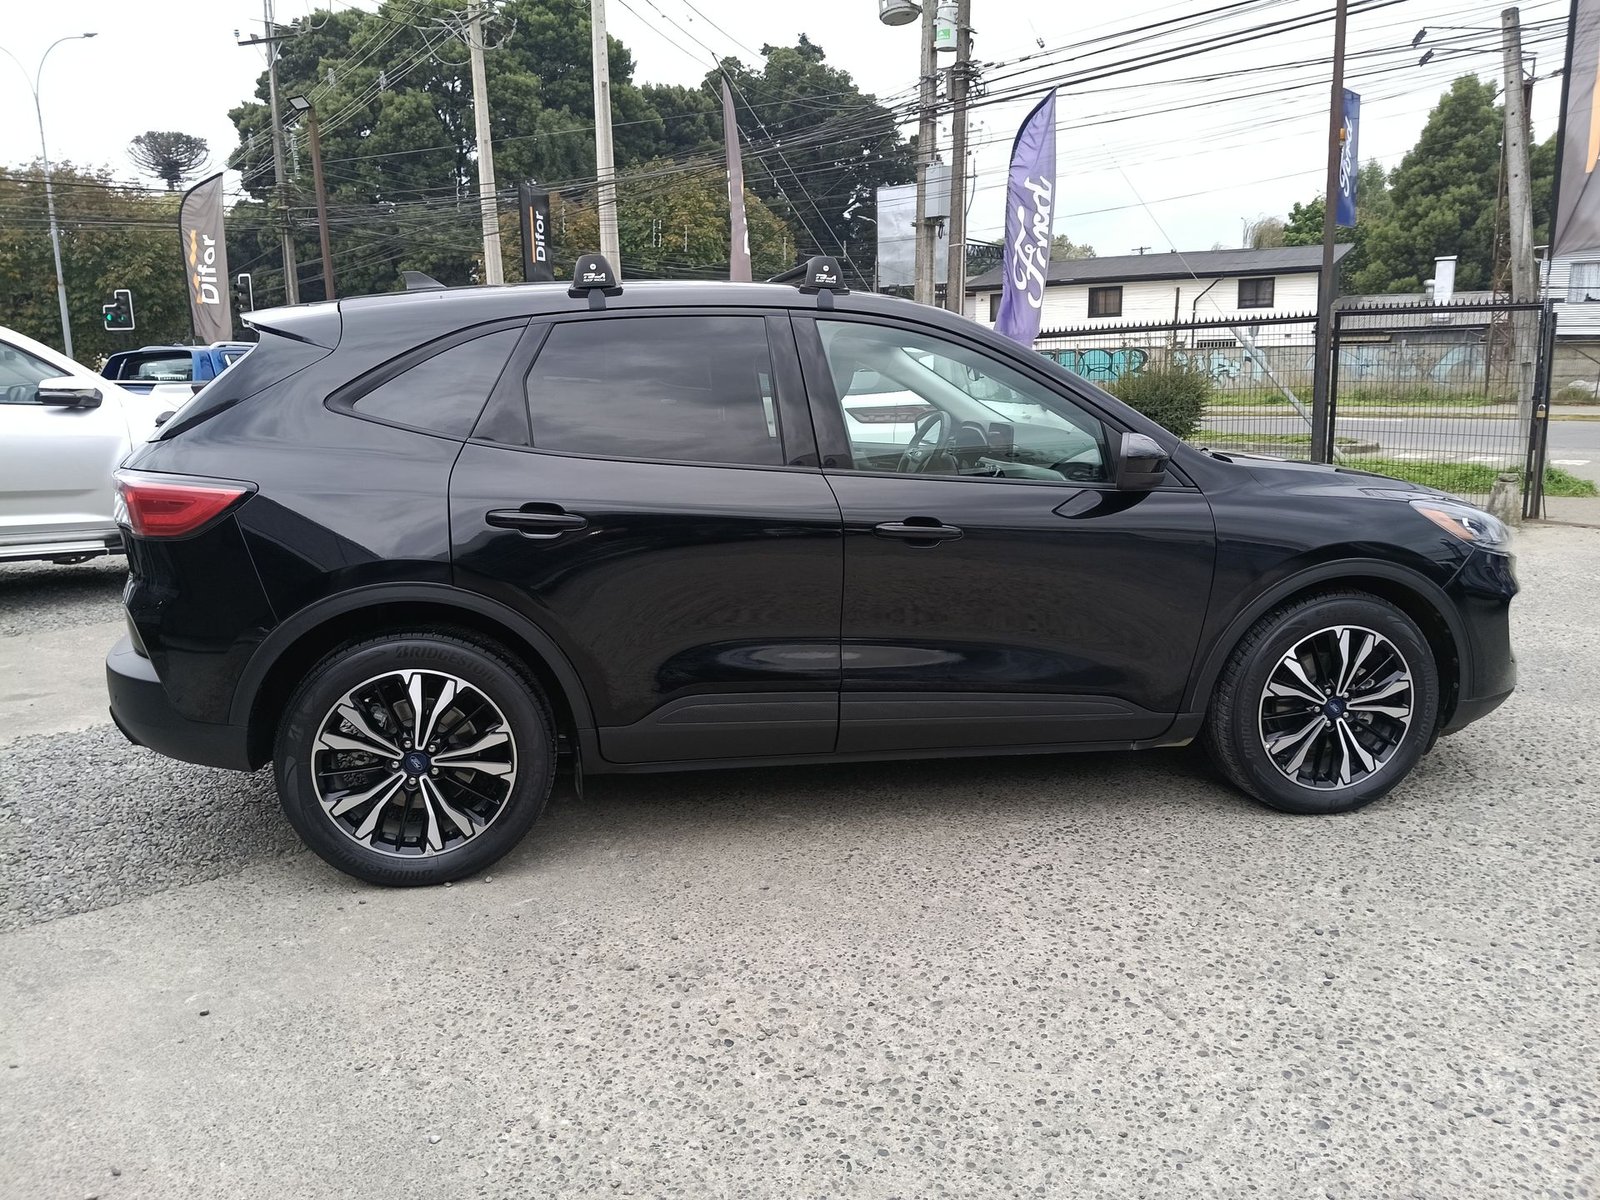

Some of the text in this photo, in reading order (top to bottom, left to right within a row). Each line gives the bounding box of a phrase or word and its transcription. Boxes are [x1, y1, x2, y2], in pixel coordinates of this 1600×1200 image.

[1340, 115, 1353, 198] Ford
[197, 234, 220, 304] Difor
[535, 210, 546, 262] Difor
[1013, 175, 1052, 308] Ford
[395, 645, 499, 683] BRIDGESTONE
